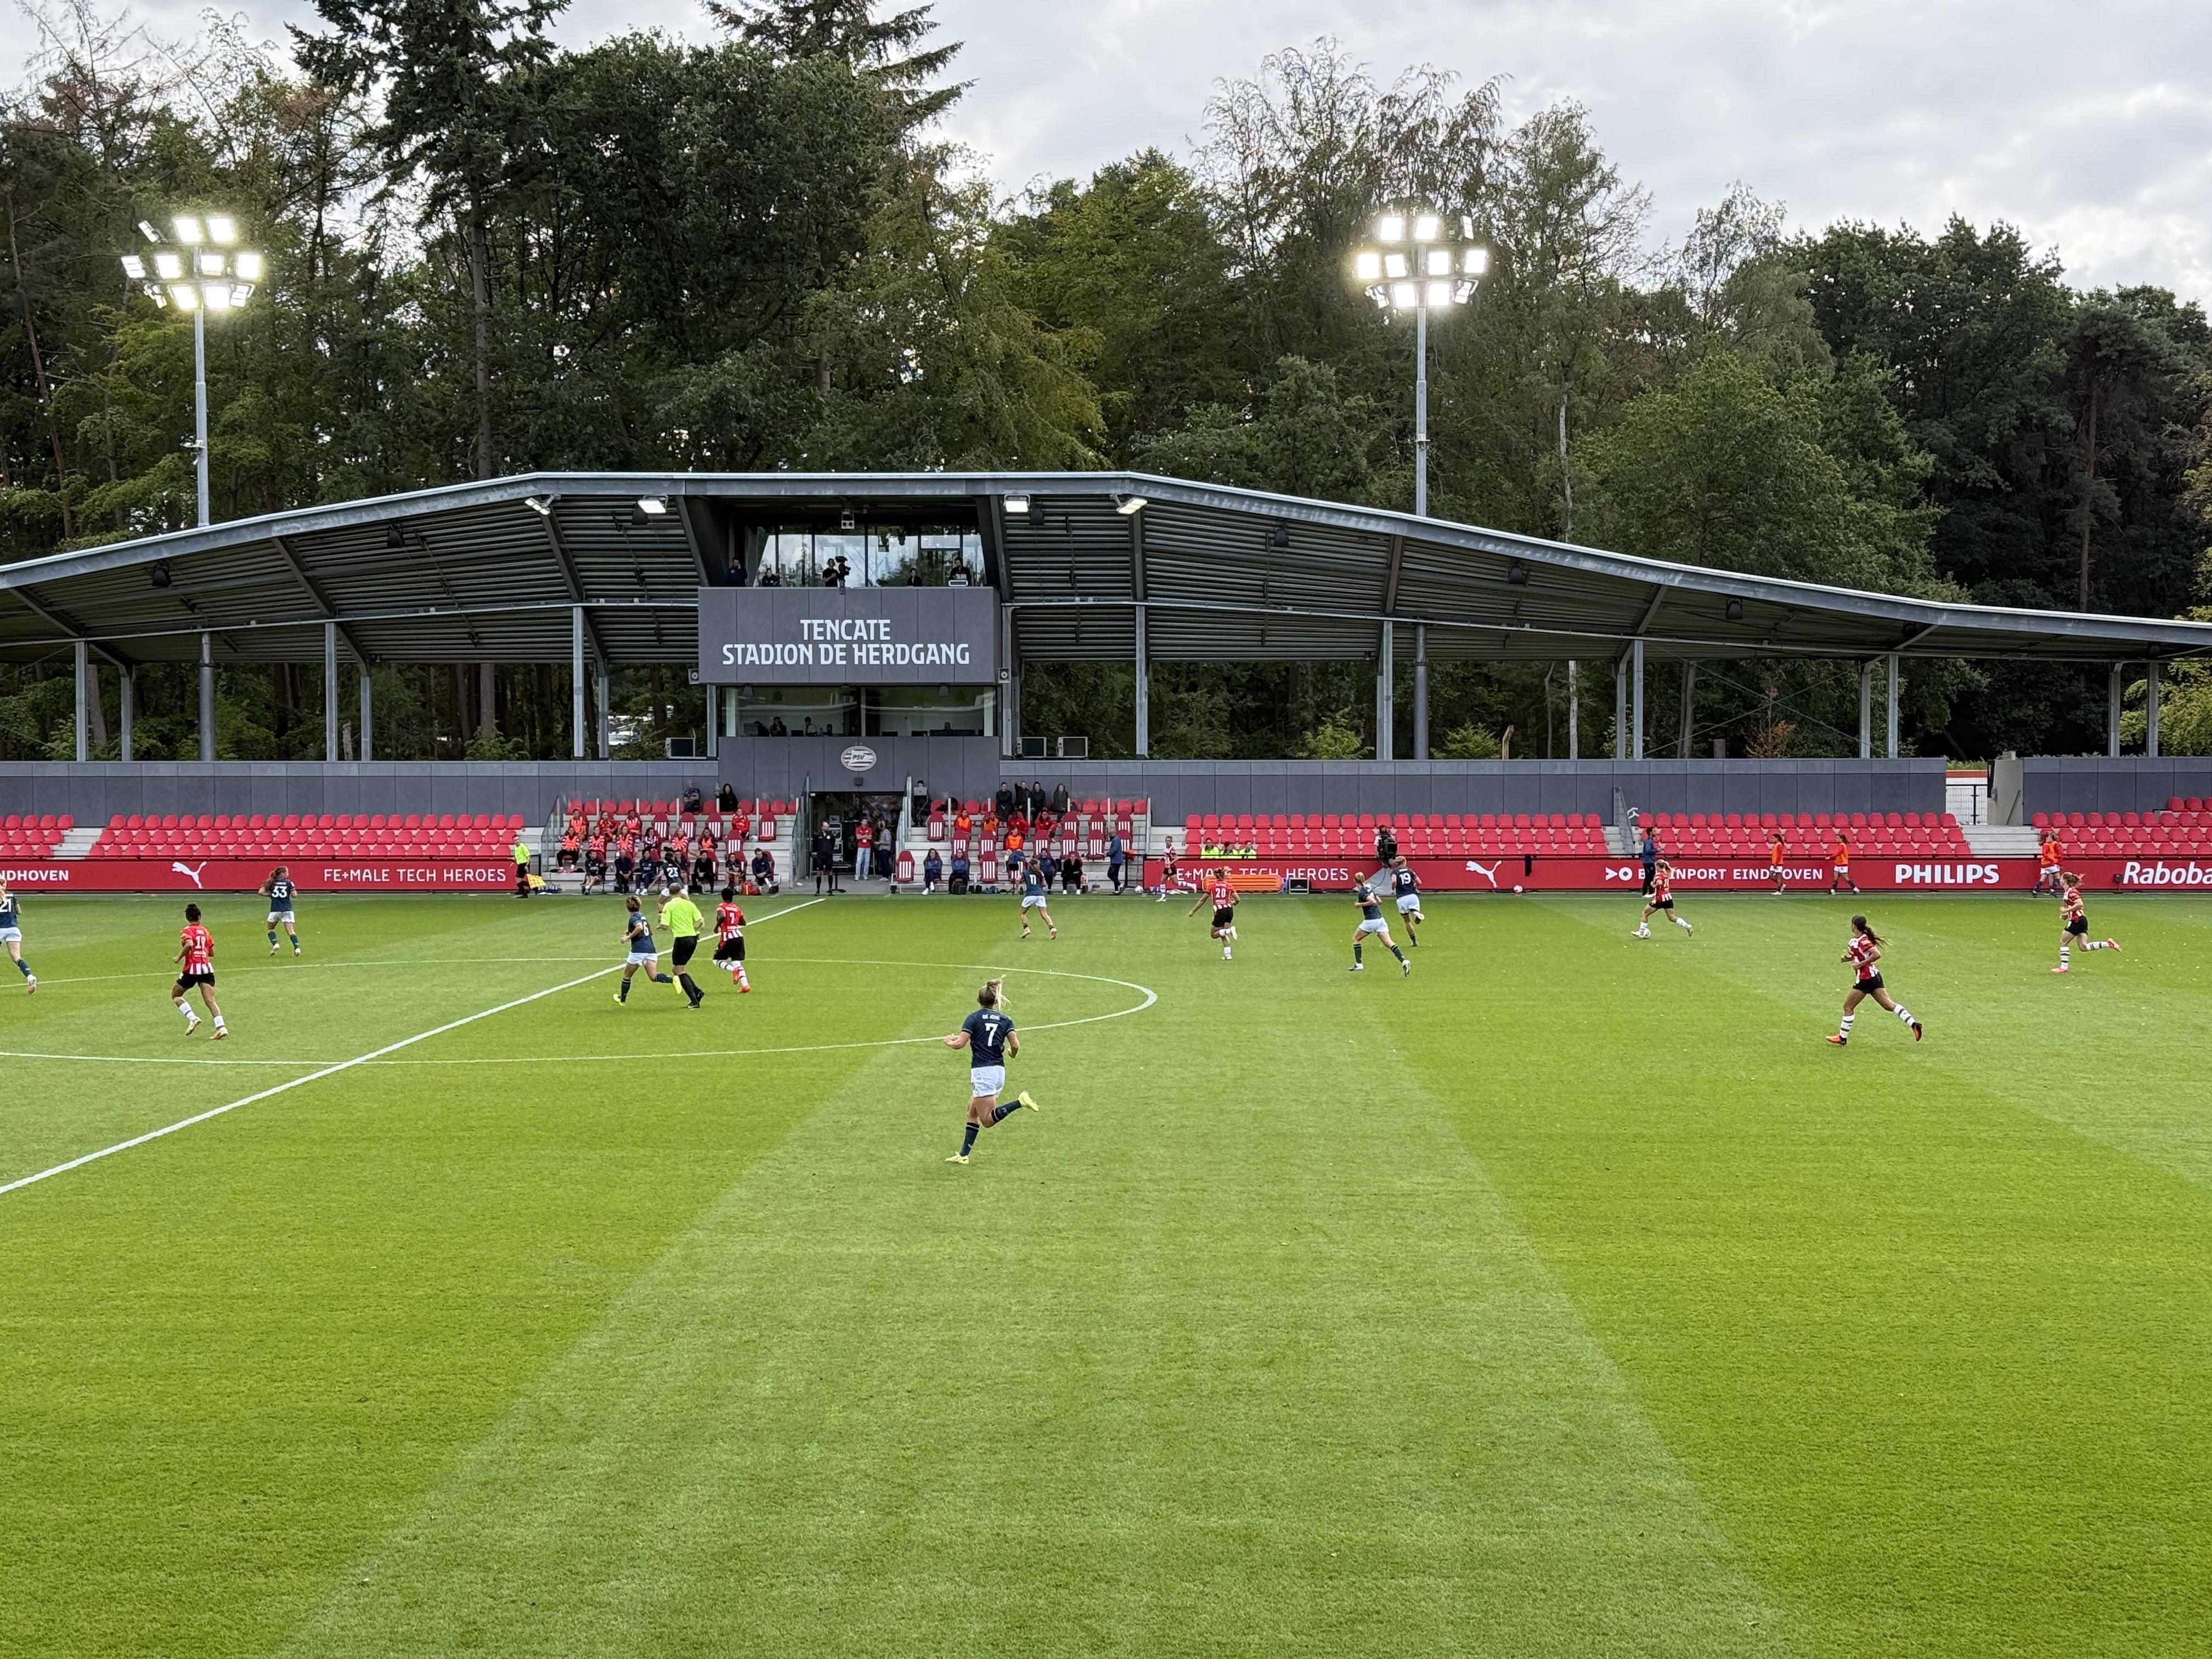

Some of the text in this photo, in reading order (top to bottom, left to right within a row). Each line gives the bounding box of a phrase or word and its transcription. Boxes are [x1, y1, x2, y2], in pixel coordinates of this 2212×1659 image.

[800, 619, 891, 641] TENCATE
[723, 644, 970, 665] STADION DE HERDGANG
[324, 868, 506, 882] FE+MALE TECH HEROES
[667, 867, 679, 877] 23
[1286, 868, 1348, 881] HEROES
[1399, 872, 1411, 885] 19
[1638, 868, 1823, 880] BINPORT EINDOVEN
[1895, 864, 2000, 884] PHILIPS
[2123, 861, 2212, 884] Raboba
[1029, 874, 1036, 885] 11
[272, 885, 287, 898] 33
[1215, 888, 1226, 898] 20
[984, 1023, 999, 1047] 7
